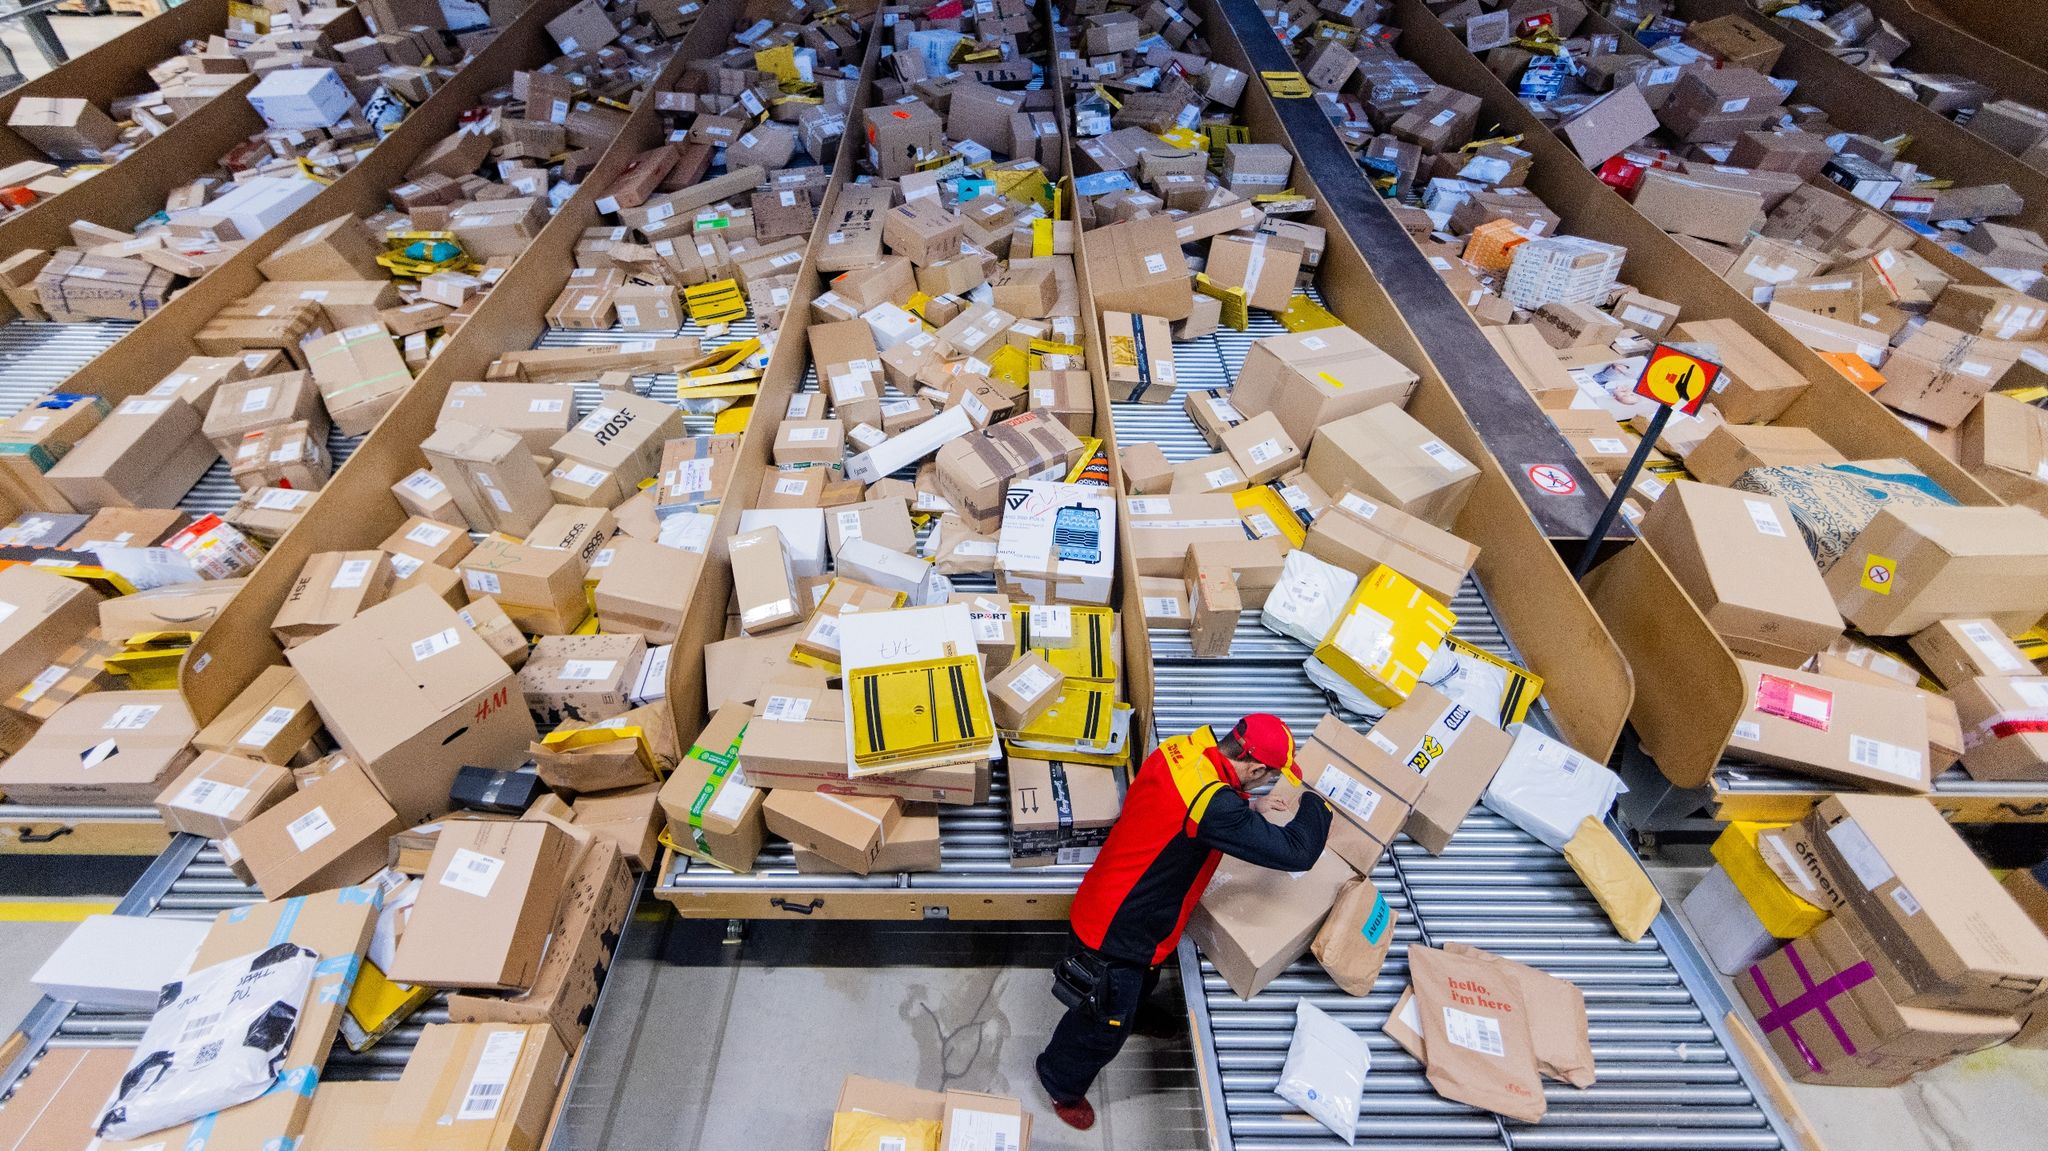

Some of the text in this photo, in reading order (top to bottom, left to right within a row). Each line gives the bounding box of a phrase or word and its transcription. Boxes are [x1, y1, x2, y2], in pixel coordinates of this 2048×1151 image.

[594, 406, 637, 448] ROSE
[289, 576, 312, 602] HSE
[1444, 704, 1472, 732] MOTO
[1795, 840, 1846, 909] öffnen!
[1368, 892, 1388, 937] EEKDAY
[1448, 977, 1491, 996] hello,
[1451, 990, 1513, 1013] i'm here
